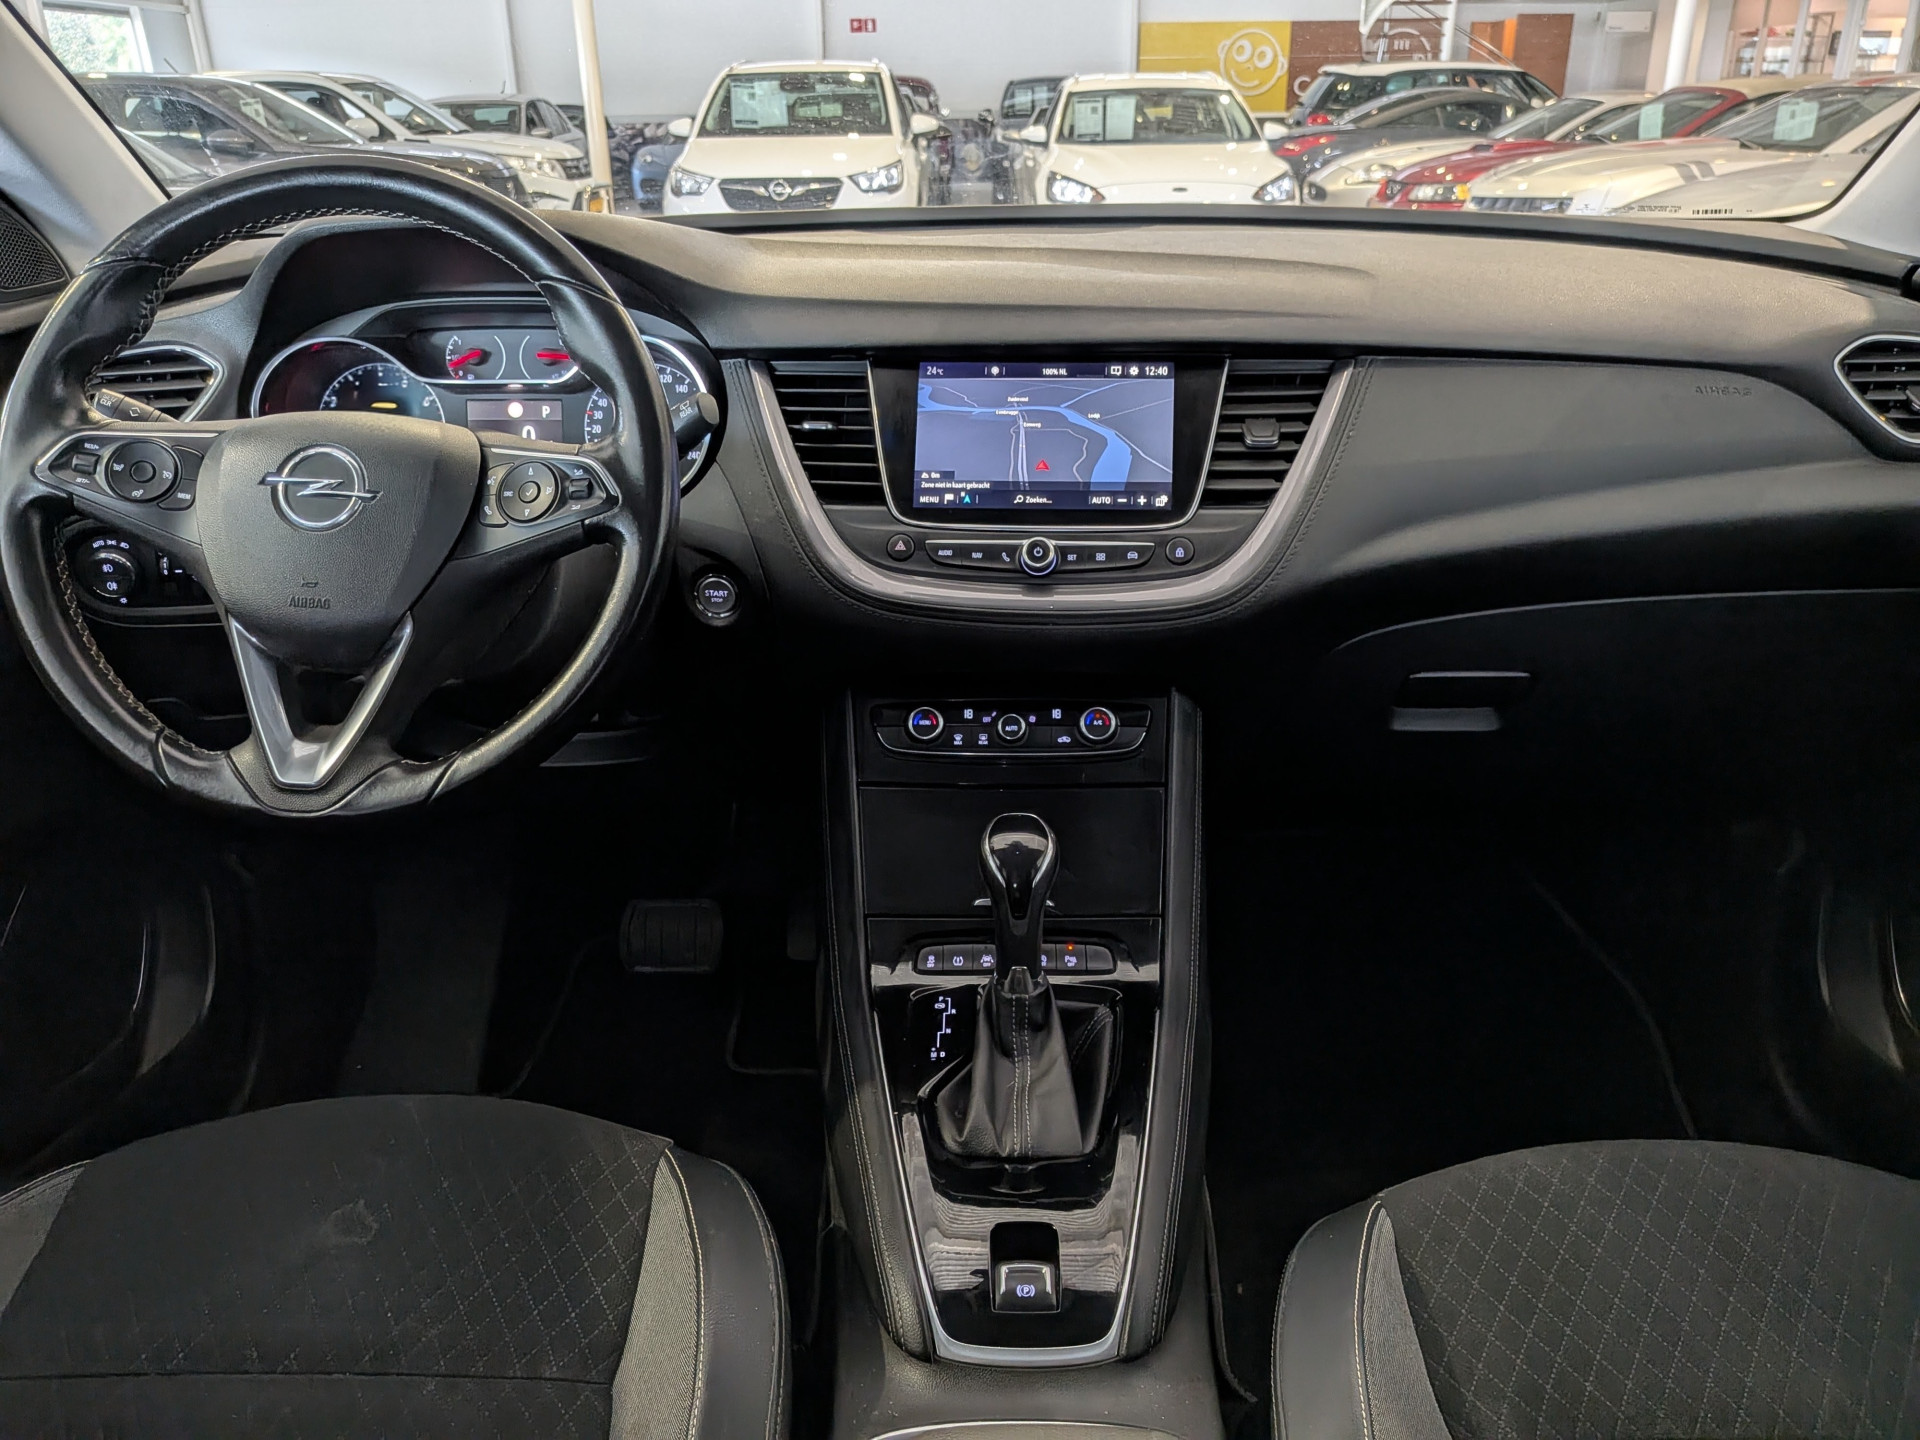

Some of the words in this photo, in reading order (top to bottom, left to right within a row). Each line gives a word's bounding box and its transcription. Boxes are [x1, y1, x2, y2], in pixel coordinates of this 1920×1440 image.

[1145, 366, 1168, 376] 12:40
[675, 384, 688, 393] 140
[100, 399, 112, 407] CLR
[597, 398, 607, 407] 40
[541, 405, 550, 418] P
[593, 410, 603, 419] 30
[679, 407, 693, 419] REAR
[592, 425, 601, 433] 20
[966, 482, 990, 490] gebracht
[177, 492, 192, 500] MEM
[705, 589, 729, 597] START
[288, 596, 331, 610] AIRBAG
[964, 709, 974, 719] 18
[1052, 708, 1062, 719] 18
